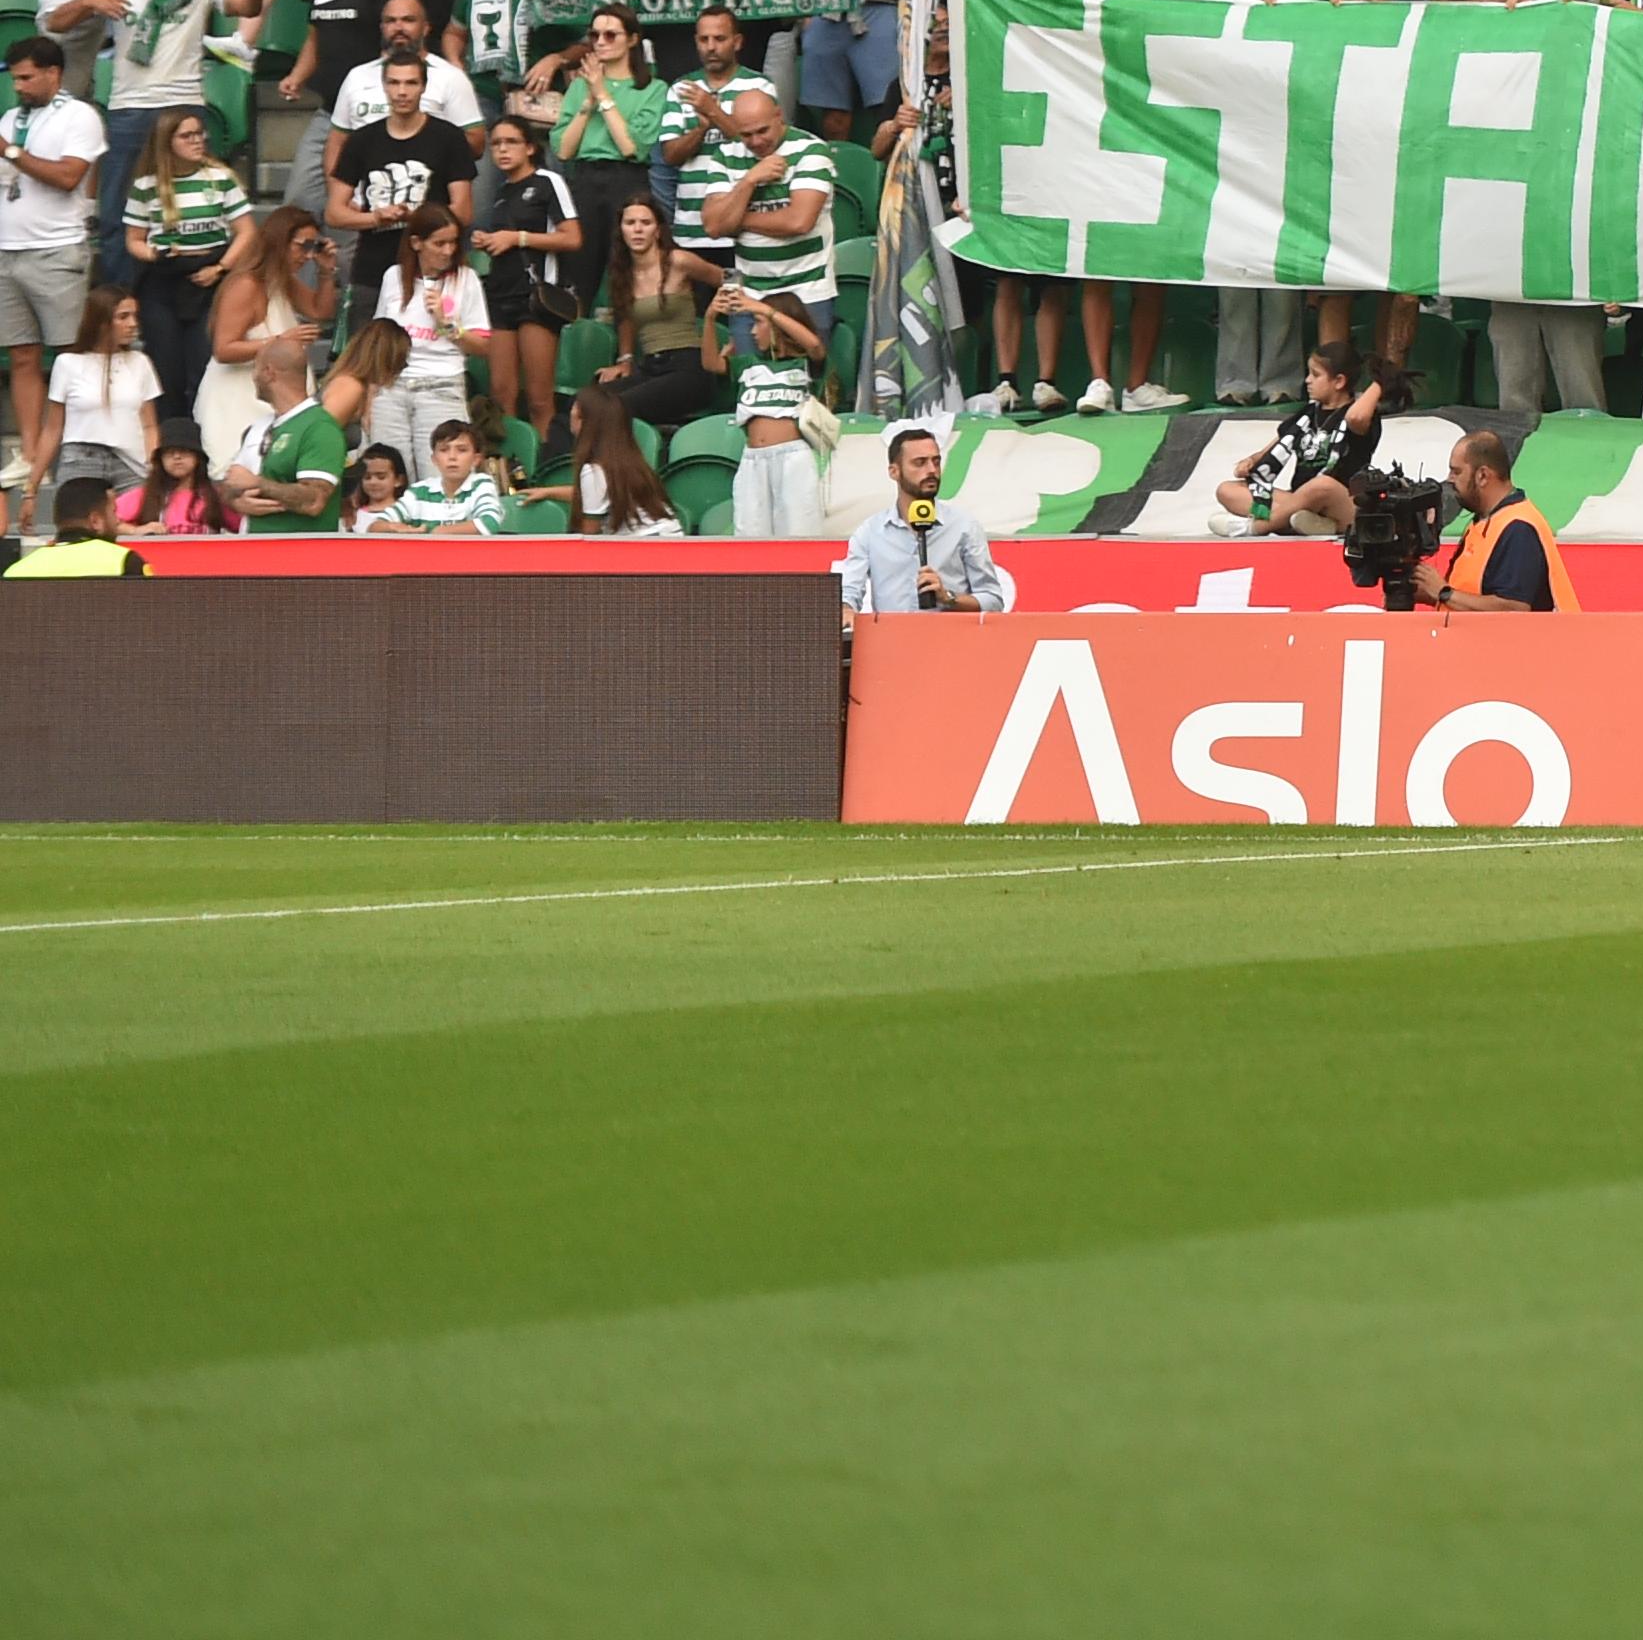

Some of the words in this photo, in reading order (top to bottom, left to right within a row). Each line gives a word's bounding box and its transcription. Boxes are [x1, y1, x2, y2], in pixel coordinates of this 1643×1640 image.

[177, 216, 216, 233] etano
[408, 324, 438, 341] tano
[756, 389, 806, 403] BETANO
